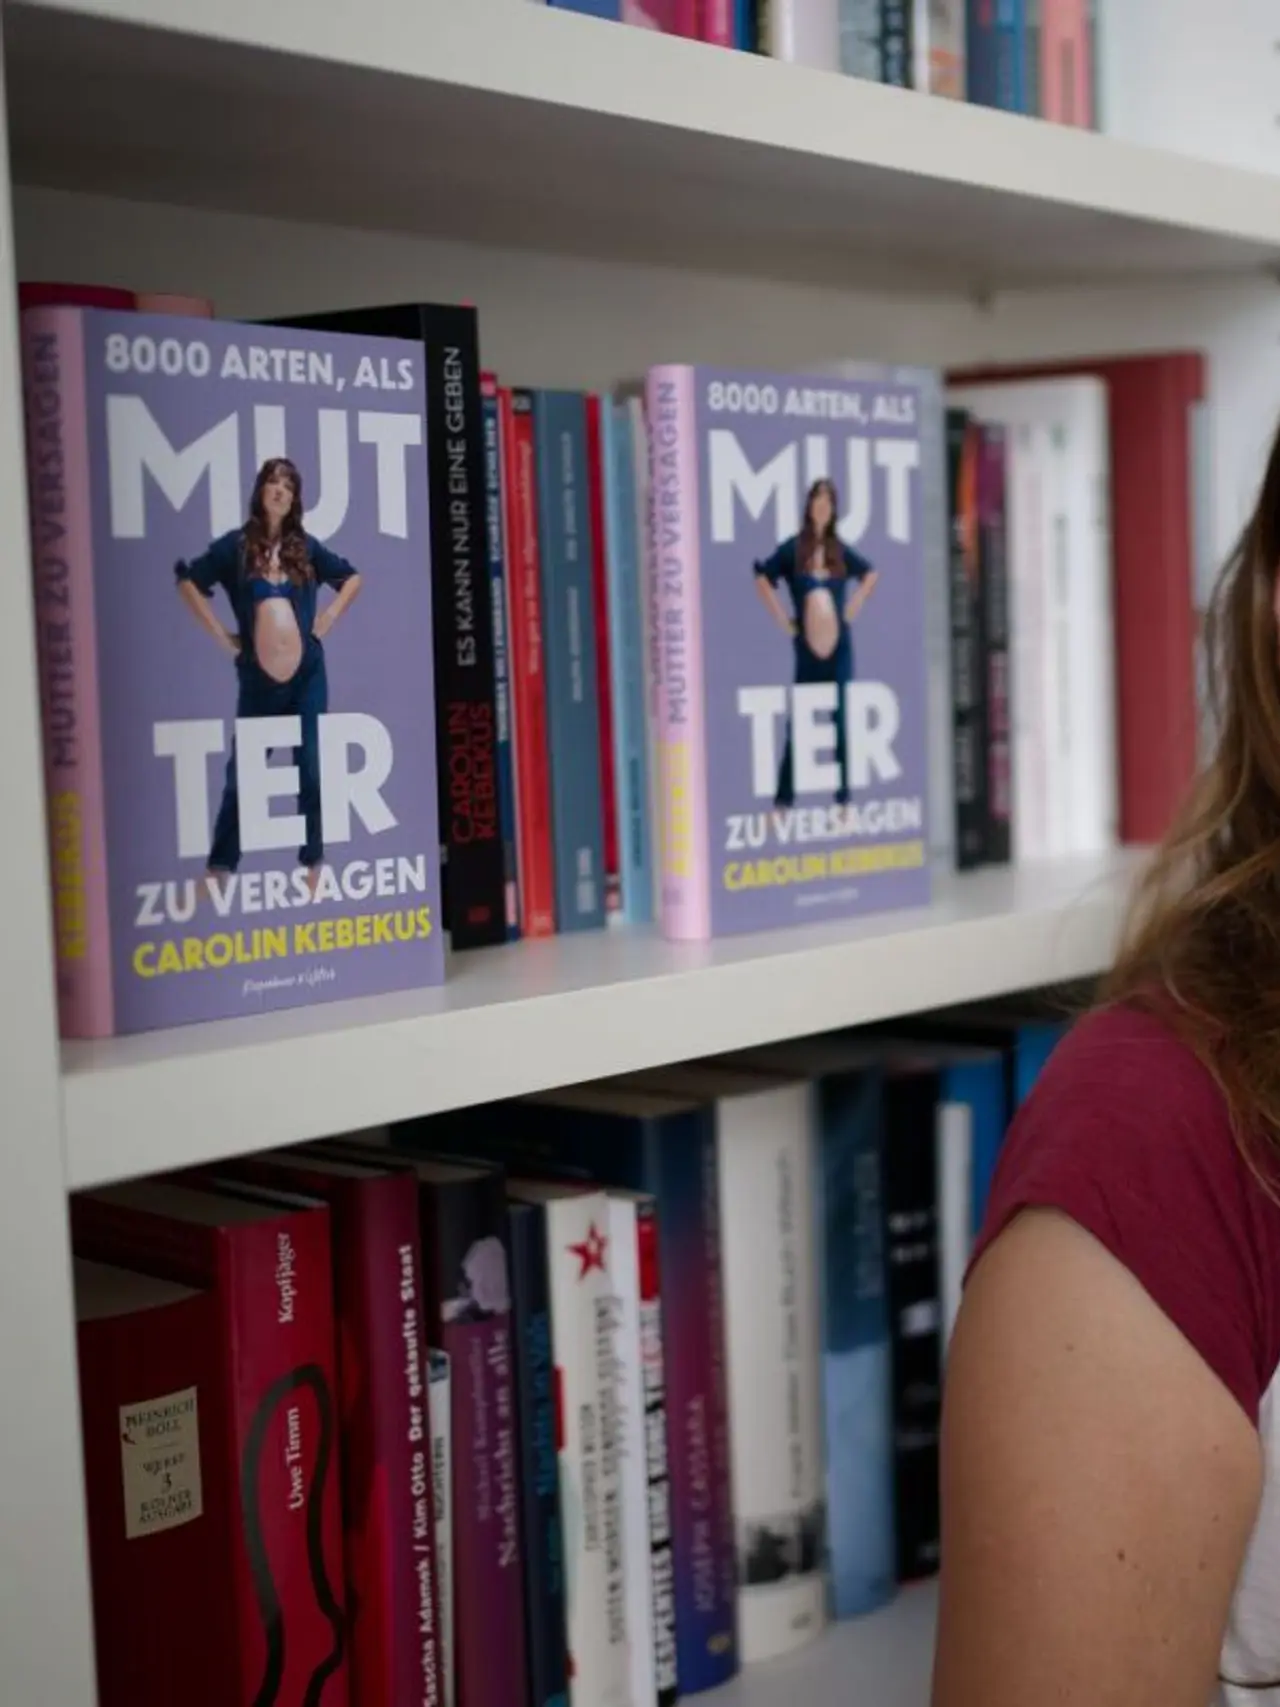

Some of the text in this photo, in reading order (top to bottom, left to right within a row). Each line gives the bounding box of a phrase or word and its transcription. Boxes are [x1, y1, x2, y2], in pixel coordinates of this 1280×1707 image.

[105, 333, 415, 393] 8000 ARTEN, ALS
[707, 381, 916, 424] 8000 ARTEN, ALS
[105, 393, 422, 540] MUT
[443, 345, 479, 667] ES KANN NUR EINE GEBEN
[655, 381, 682, 547] VERSAGEN
[709, 429, 920, 543] MUT
[662, 557, 685, 596] ZU
[664, 608, 688, 724] MUTTER
[153, 712, 399, 860] TER
[446, 701, 473, 844] CAROLIN
[737, 681, 902, 798] TER
[723, 852, 826, 891] CAROLIN
[725, 798, 922, 850] ZU VERSAGEN
[134, 855, 427, 928] ZU VERSAGEN
[133, 906, 433, 978] CAROLIN KEBEKUS
[276, 1232, 296, 1323] Kopfjäger
[398, 1244, 424, 1442] Der gekaufte Staat
[284, 1407, 304, 1511] Uwe Timm
[410, 1452, 427, 1496] Otto
[488, 1329, 519, 1568] Nachricht an alle
[412, 1498, 428, 1539] Kim
[415, 1557, 434, 1633] Adamek
